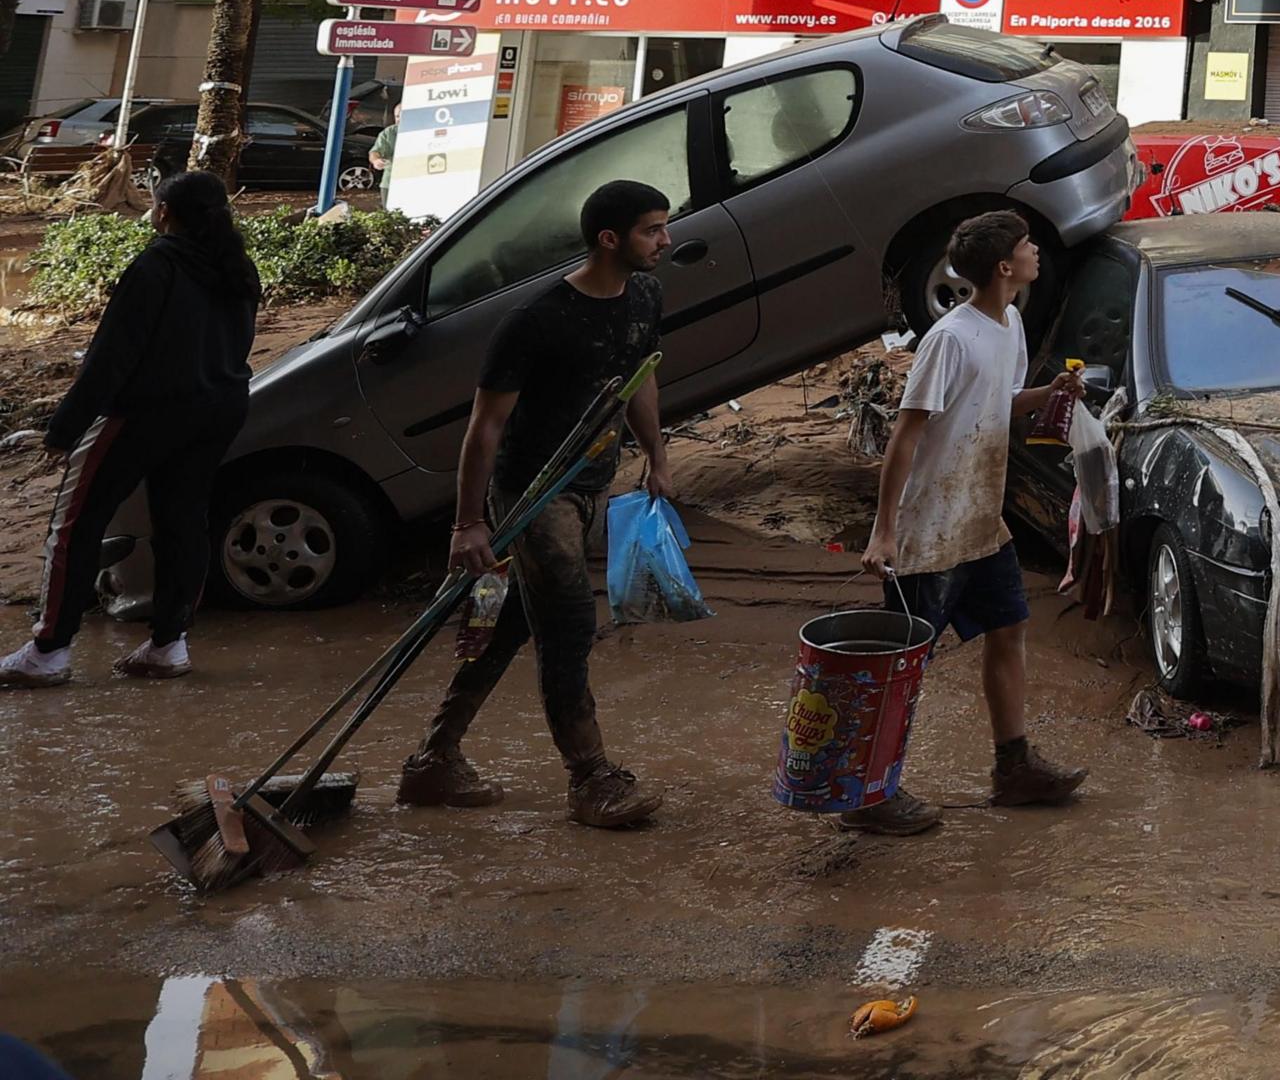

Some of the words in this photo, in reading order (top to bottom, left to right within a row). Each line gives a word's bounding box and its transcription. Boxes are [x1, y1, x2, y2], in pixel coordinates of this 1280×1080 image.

[515, 13, 548, 25] BUENA
[735, 13, 837, 27] www.movy.es
[1010, 15, 1026, 27] En
[1030, 15, 1087, 29] Paiporta
[1091, 16, 1131, 27] desde
[1135, 17, 1171, 28] 2016
[336, 25, 376, 37] església
[335, 38, 394, 49] Immaculada
[427, 84, 468, 101] Lowi
[567, 89, 619, 105] simyo
[793, 702, 832, 725] Chupa
[788, 716, 827, 746] Chups
[786, 758, 811, 770] FUN
